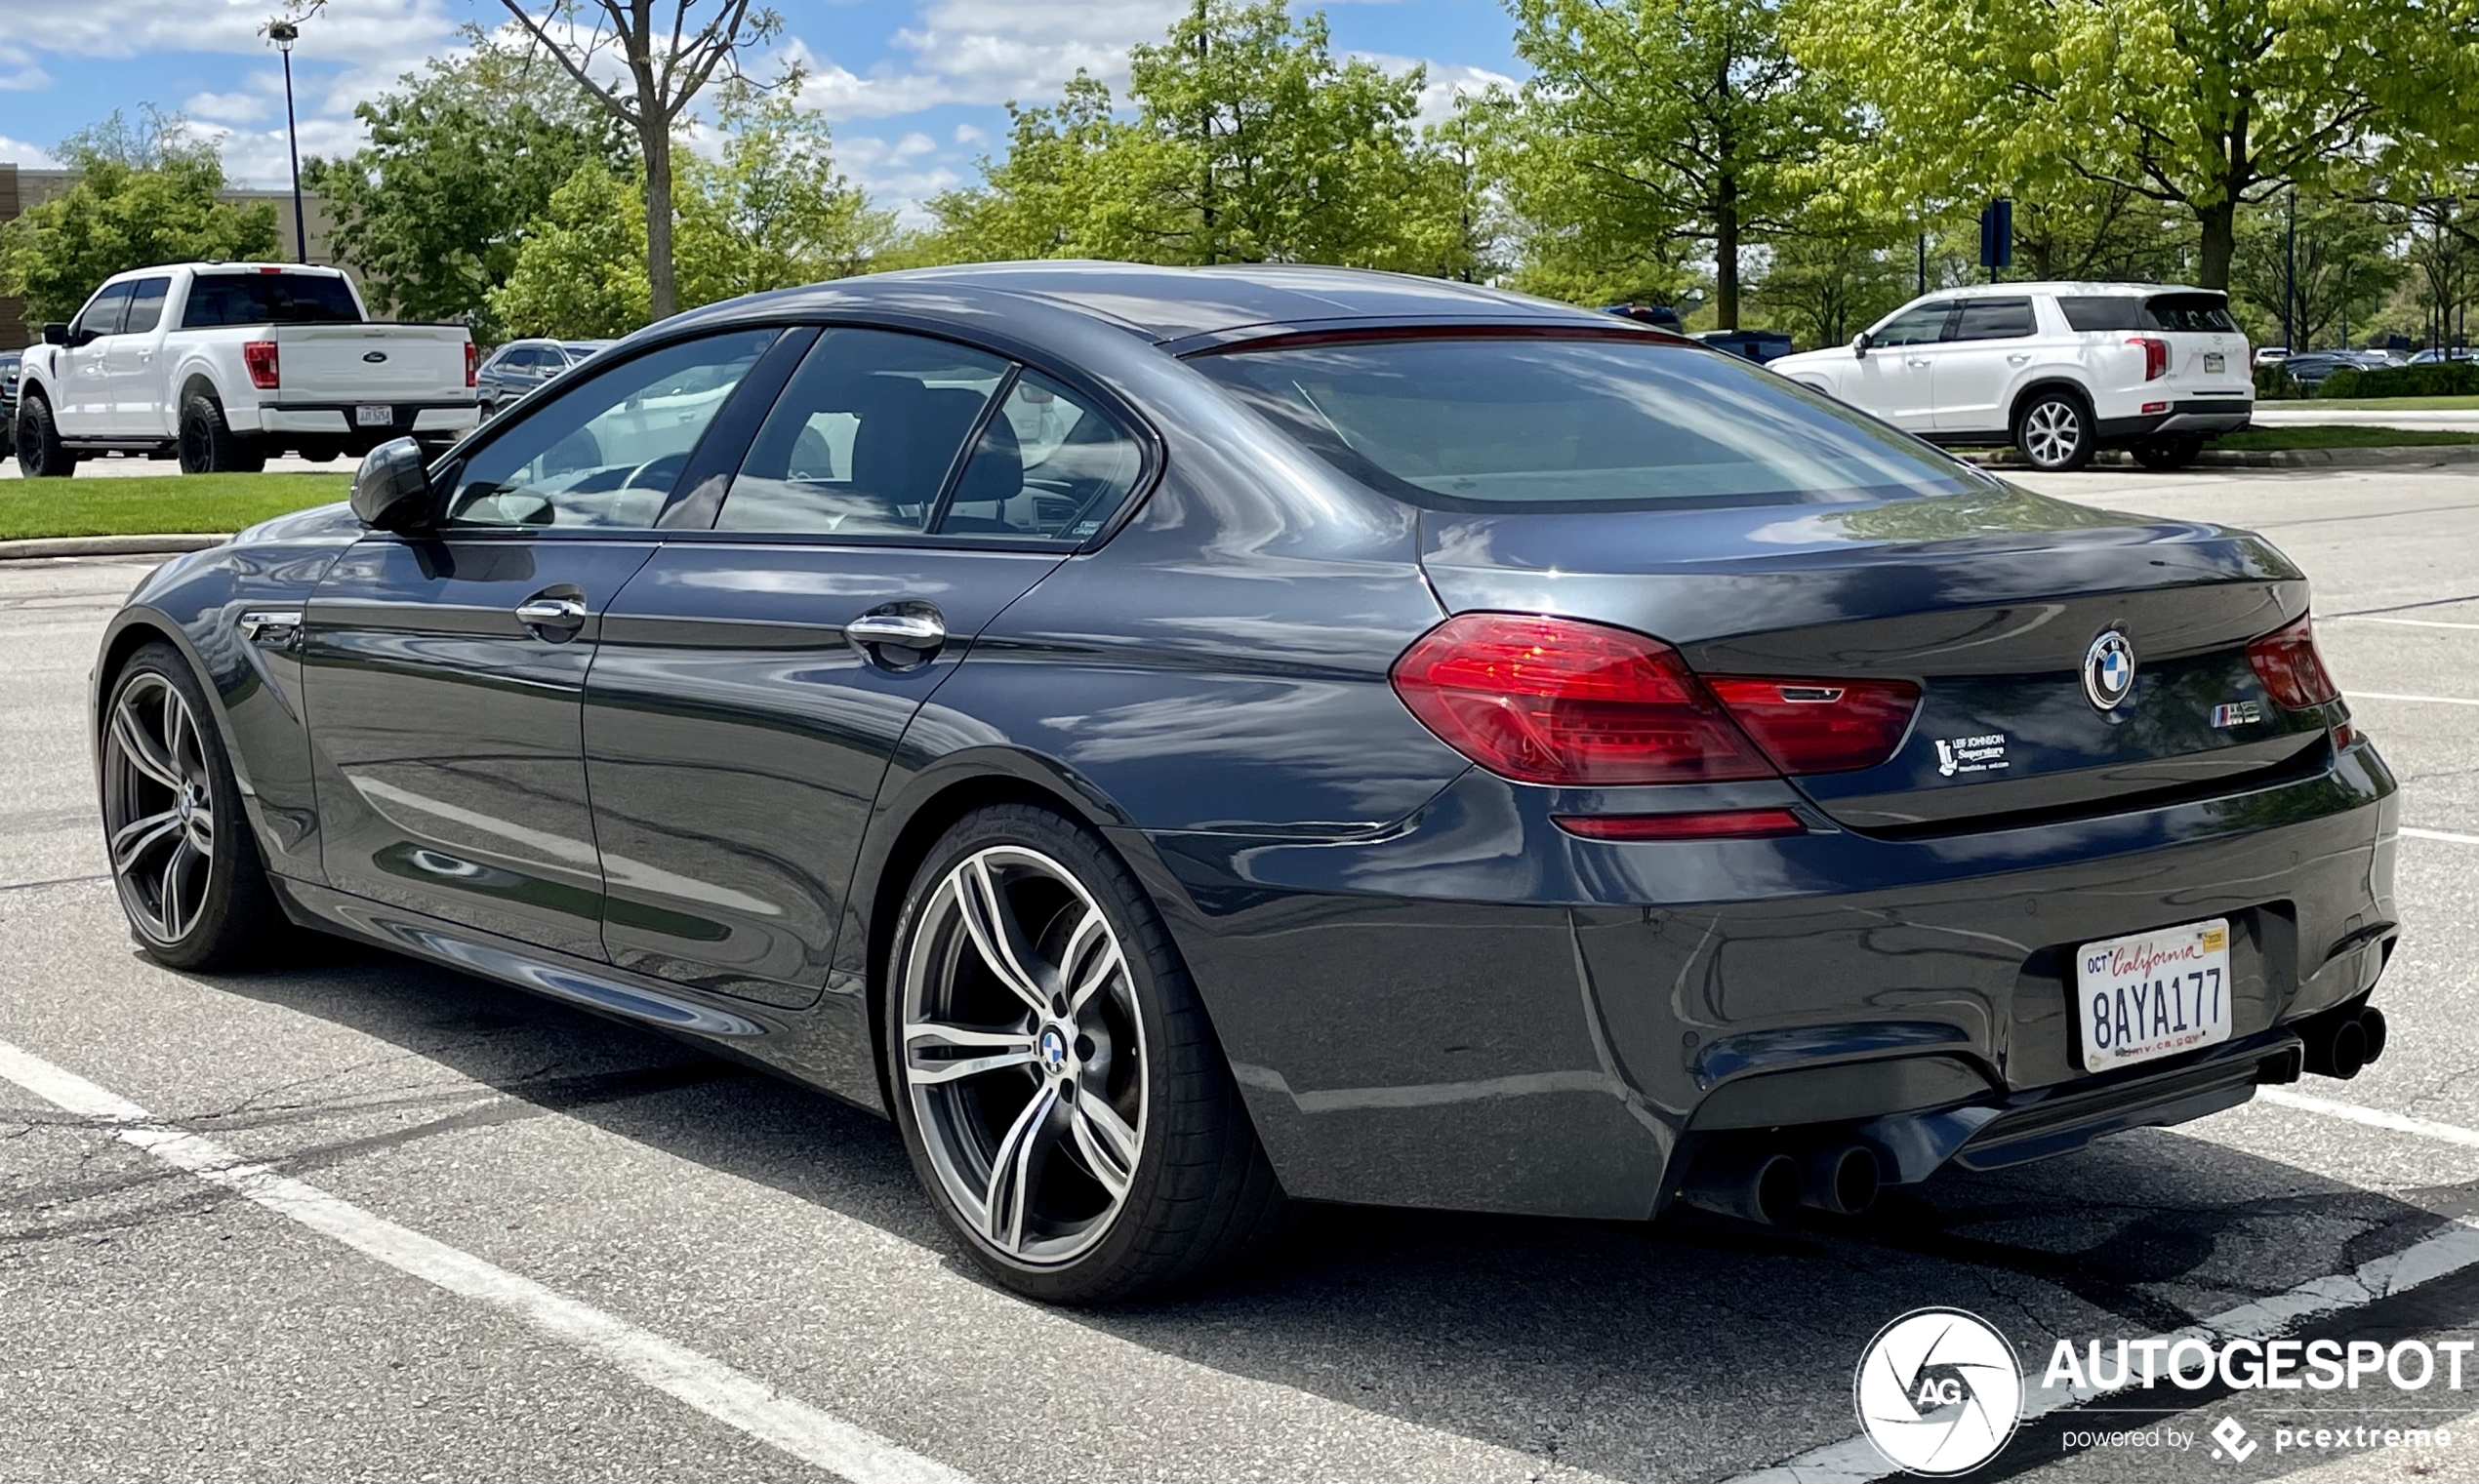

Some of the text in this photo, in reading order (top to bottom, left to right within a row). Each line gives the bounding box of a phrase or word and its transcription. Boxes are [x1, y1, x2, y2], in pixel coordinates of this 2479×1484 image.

[1968, 734, 2005, 748] JOHNSON
[2088, 943, 2204, 979] OCT California
[2093, 967, 2220, 1049] 8AYA177
